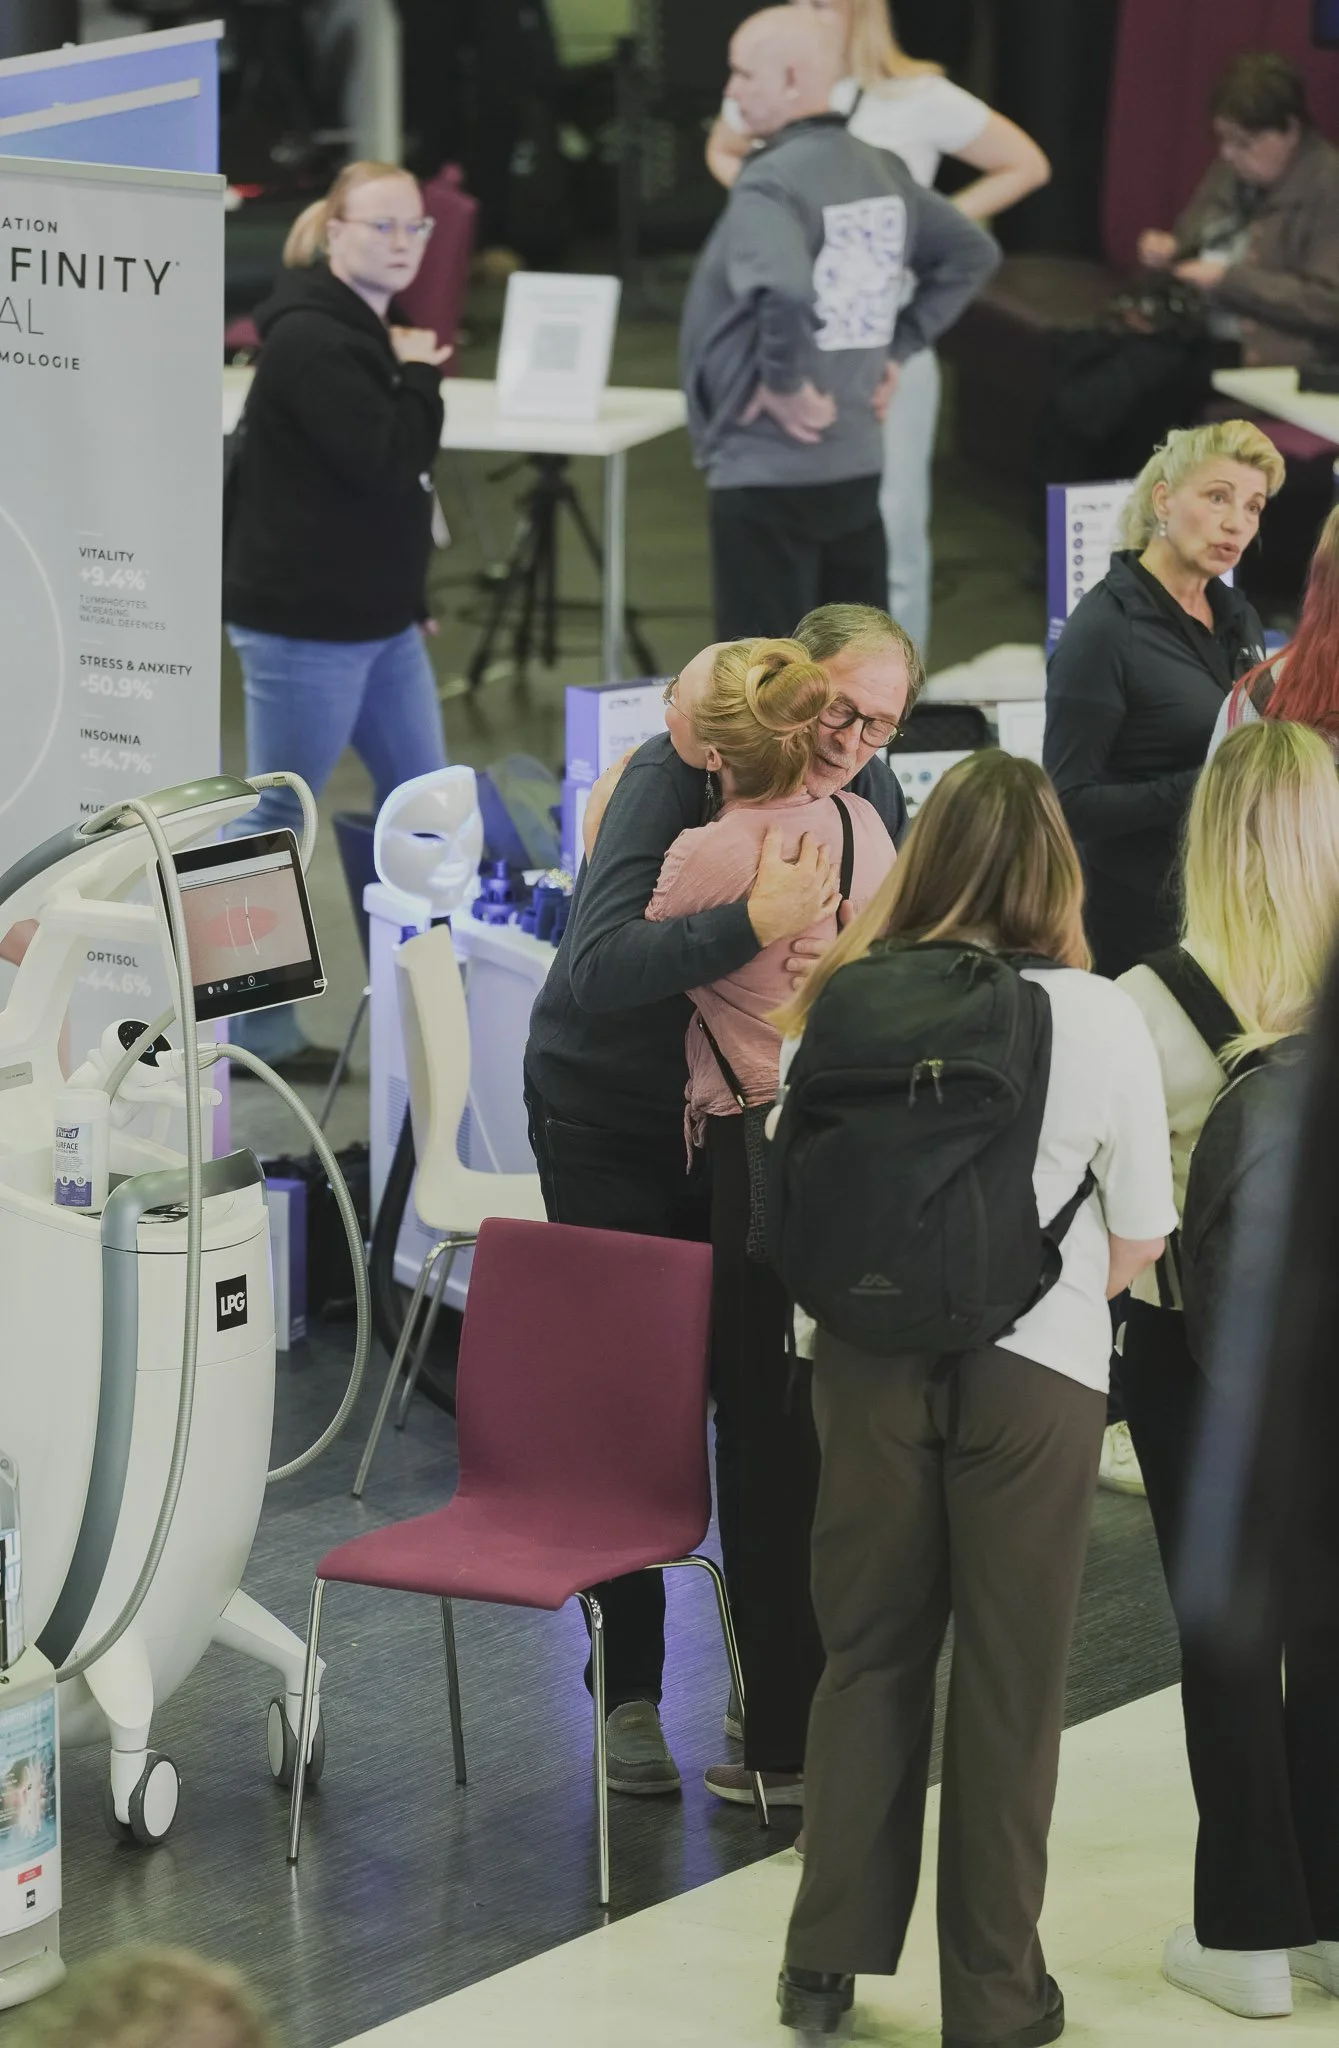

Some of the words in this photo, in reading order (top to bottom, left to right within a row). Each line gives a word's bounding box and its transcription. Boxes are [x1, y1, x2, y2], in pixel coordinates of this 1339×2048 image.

[1, 217, 58, 233] ATION
[11, 246, 171, 296] FINITY
[0, 296, 44, 335] AL
[79, 547, 135, 562] VITALITY
[79, 614, 116, 626] NATURAL
[119, 618, 166, 631] DEFENCES
[79, 655, 123, 670] STRESS
[126, 660, 134, 671] &
[138, 661, 193, 677] ANXIETY
[80, 728, 141, 746] INSOMNIA
[86, 951, 139, 968] ORTISOL
[220, 1291, 246, 1317] LPG
